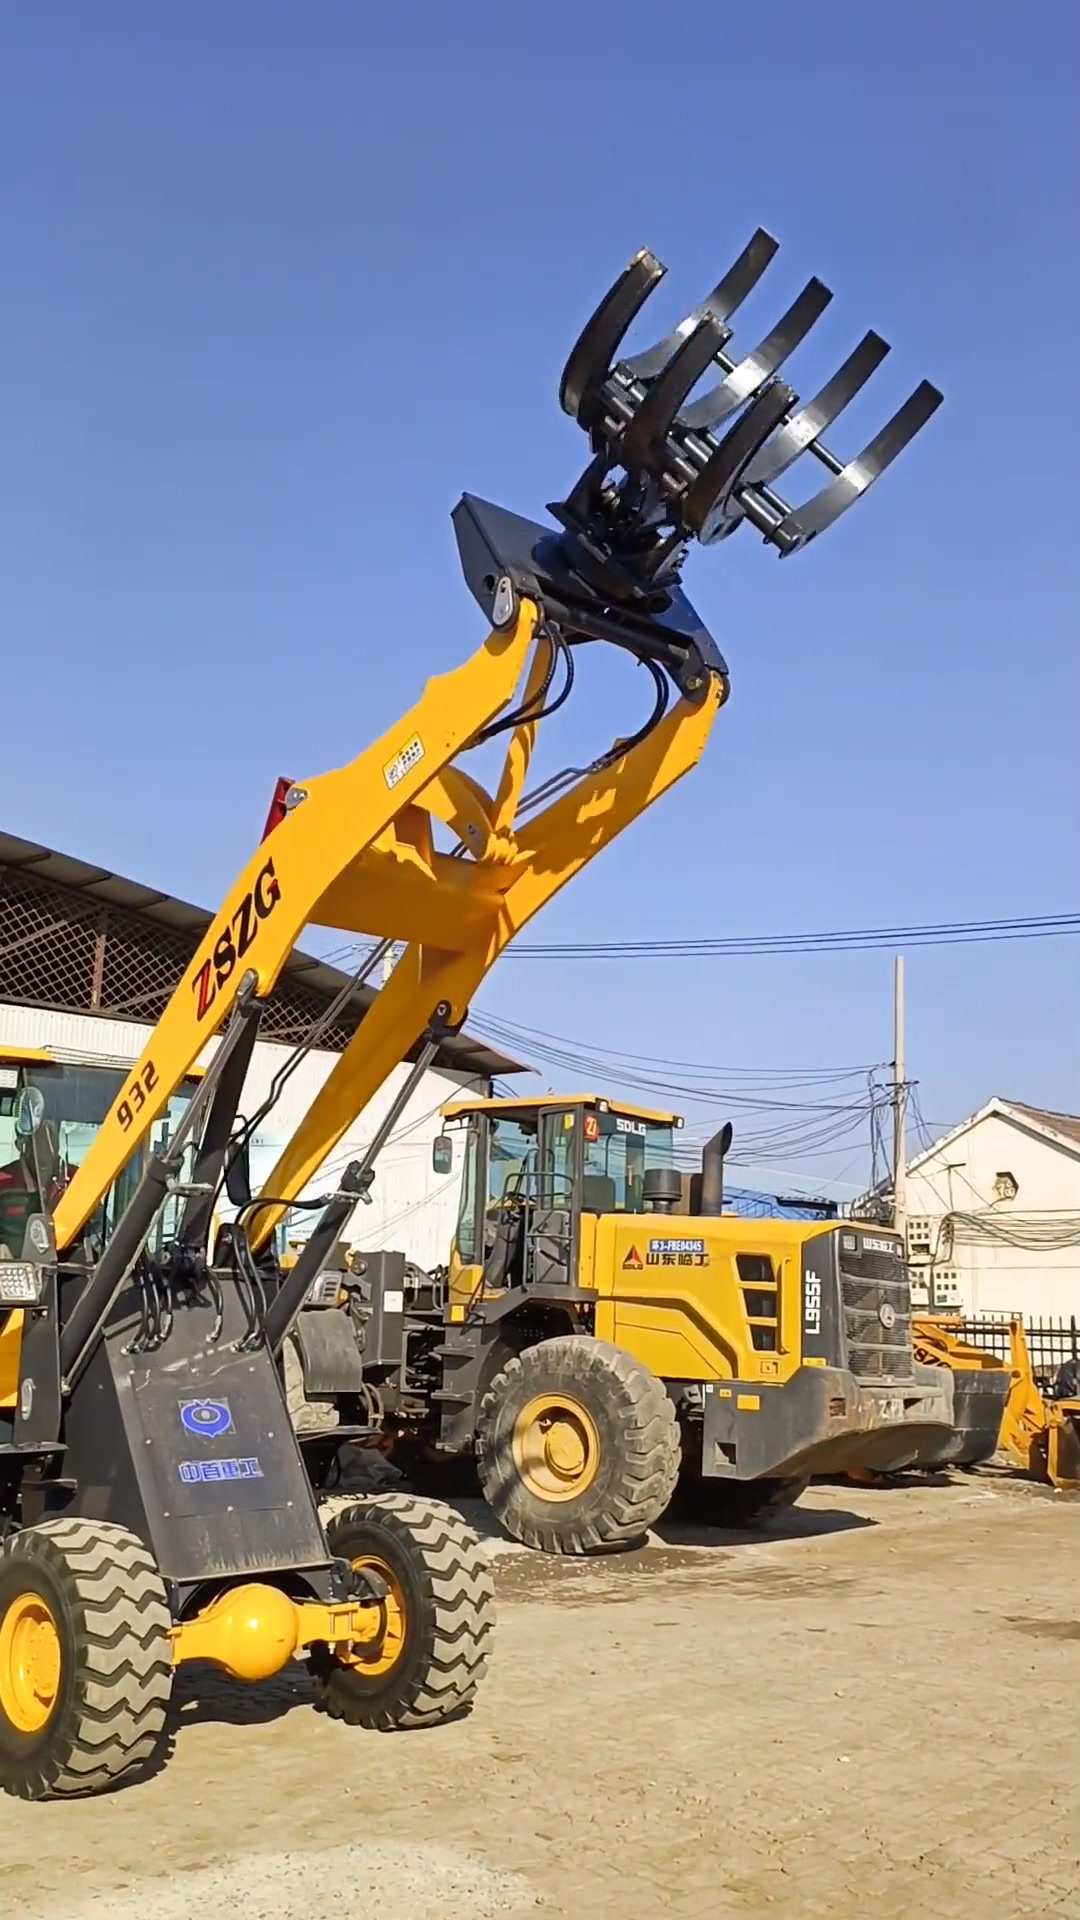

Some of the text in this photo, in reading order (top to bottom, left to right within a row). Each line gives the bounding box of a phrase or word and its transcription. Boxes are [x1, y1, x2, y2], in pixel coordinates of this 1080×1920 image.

[192, 856, 281, 1022] ZSZG
[117, 1060, 159, 1132] 932
[616, 1117, 646, 1136] SDLG
[646, 1253, 709, 1268] 山东临工
[804, 1269, 821, 1335] L955F
[179, 1457, 264, 1482] 中首重工
